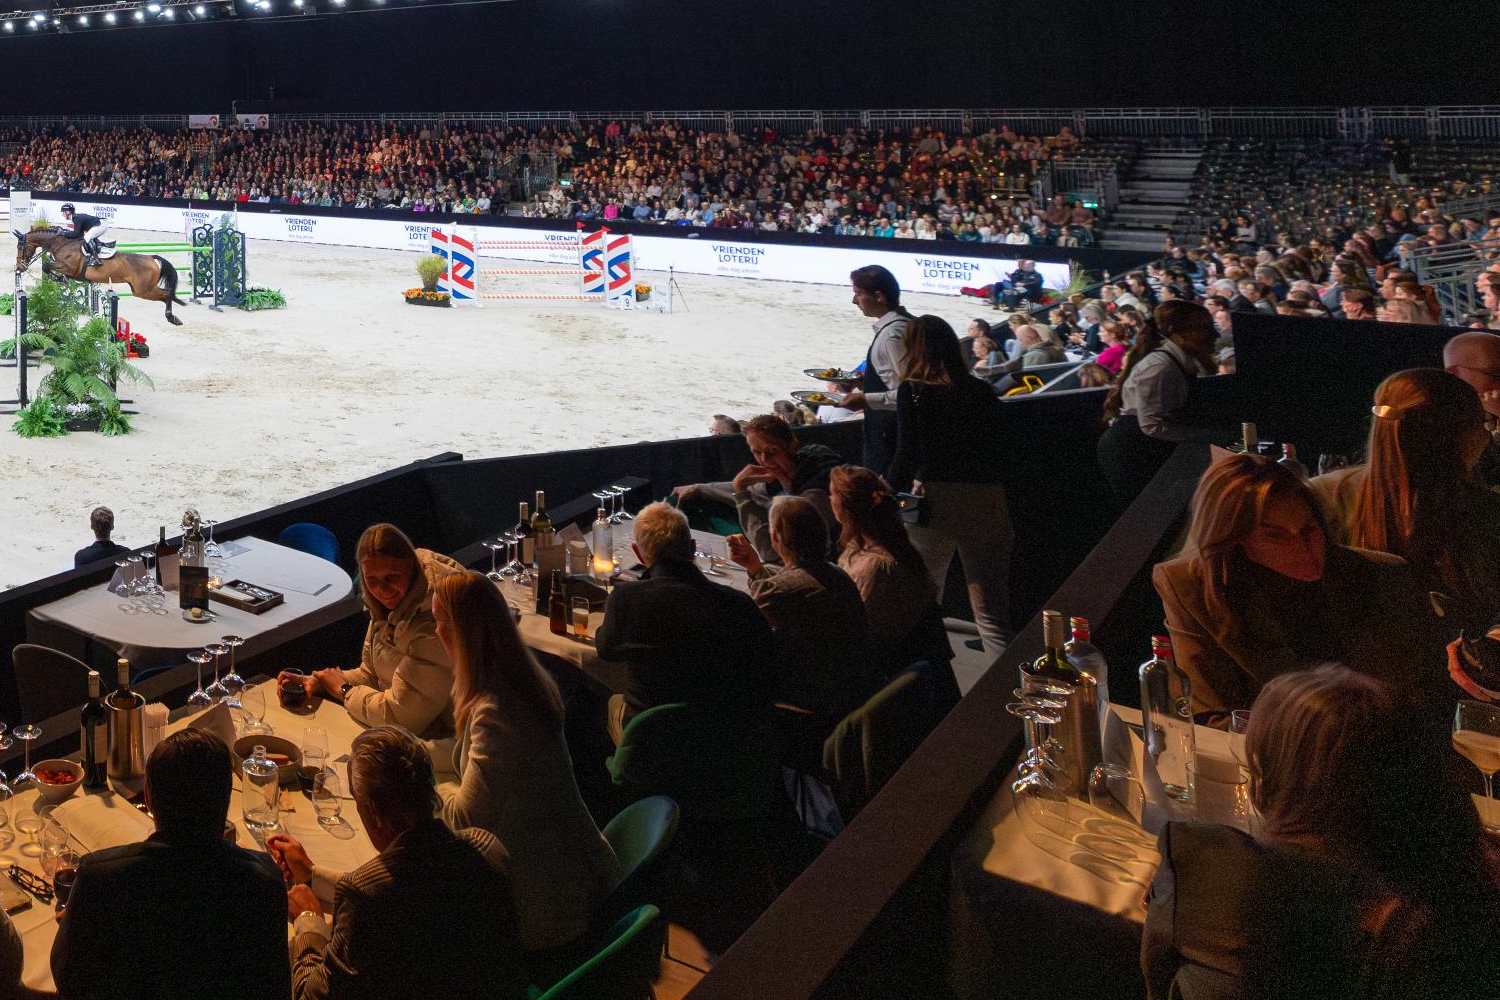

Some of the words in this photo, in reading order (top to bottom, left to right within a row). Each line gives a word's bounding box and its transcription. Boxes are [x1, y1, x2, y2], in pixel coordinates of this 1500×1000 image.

[182, 211, 209, 219] VRENDEN
[285, 217, 317, 226] VRIENDEN
[544, 234, 579, 242] VRIEND
[712, 245, 765, 256] VRIENDEN
[719, 254, 758, 265] LOTERIJ
[915, 259, 980, 271] VRIENDEN
[924, 268, 972, 281] LOTERIJ
